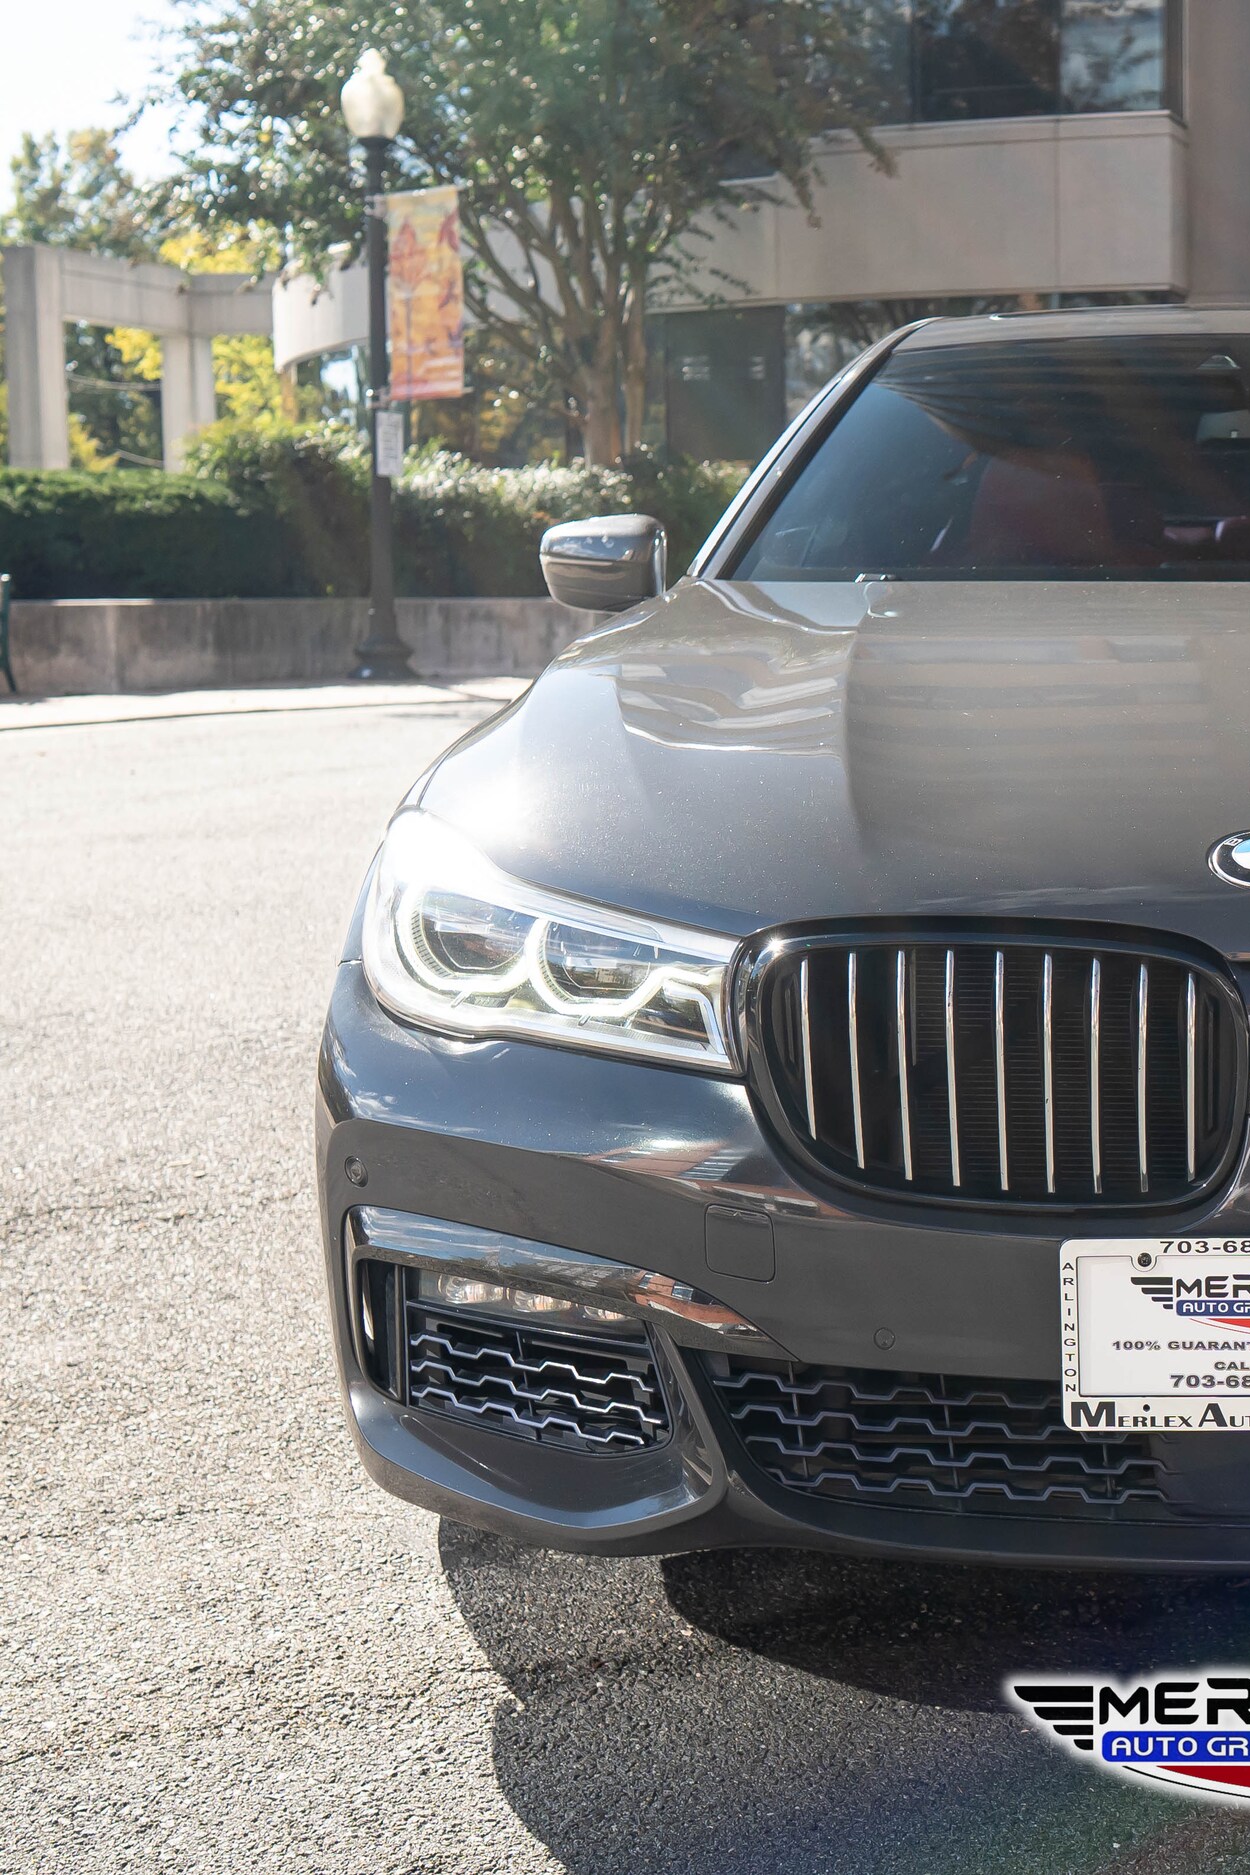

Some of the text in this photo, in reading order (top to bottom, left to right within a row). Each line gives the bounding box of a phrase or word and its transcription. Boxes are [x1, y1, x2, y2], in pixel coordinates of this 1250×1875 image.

[1182, 1302, 1229, 1314] AUTO
[1062, 1262, 1076, 1392] ARLINGTON
[1112, 1340, 1161, 1351] 100%
